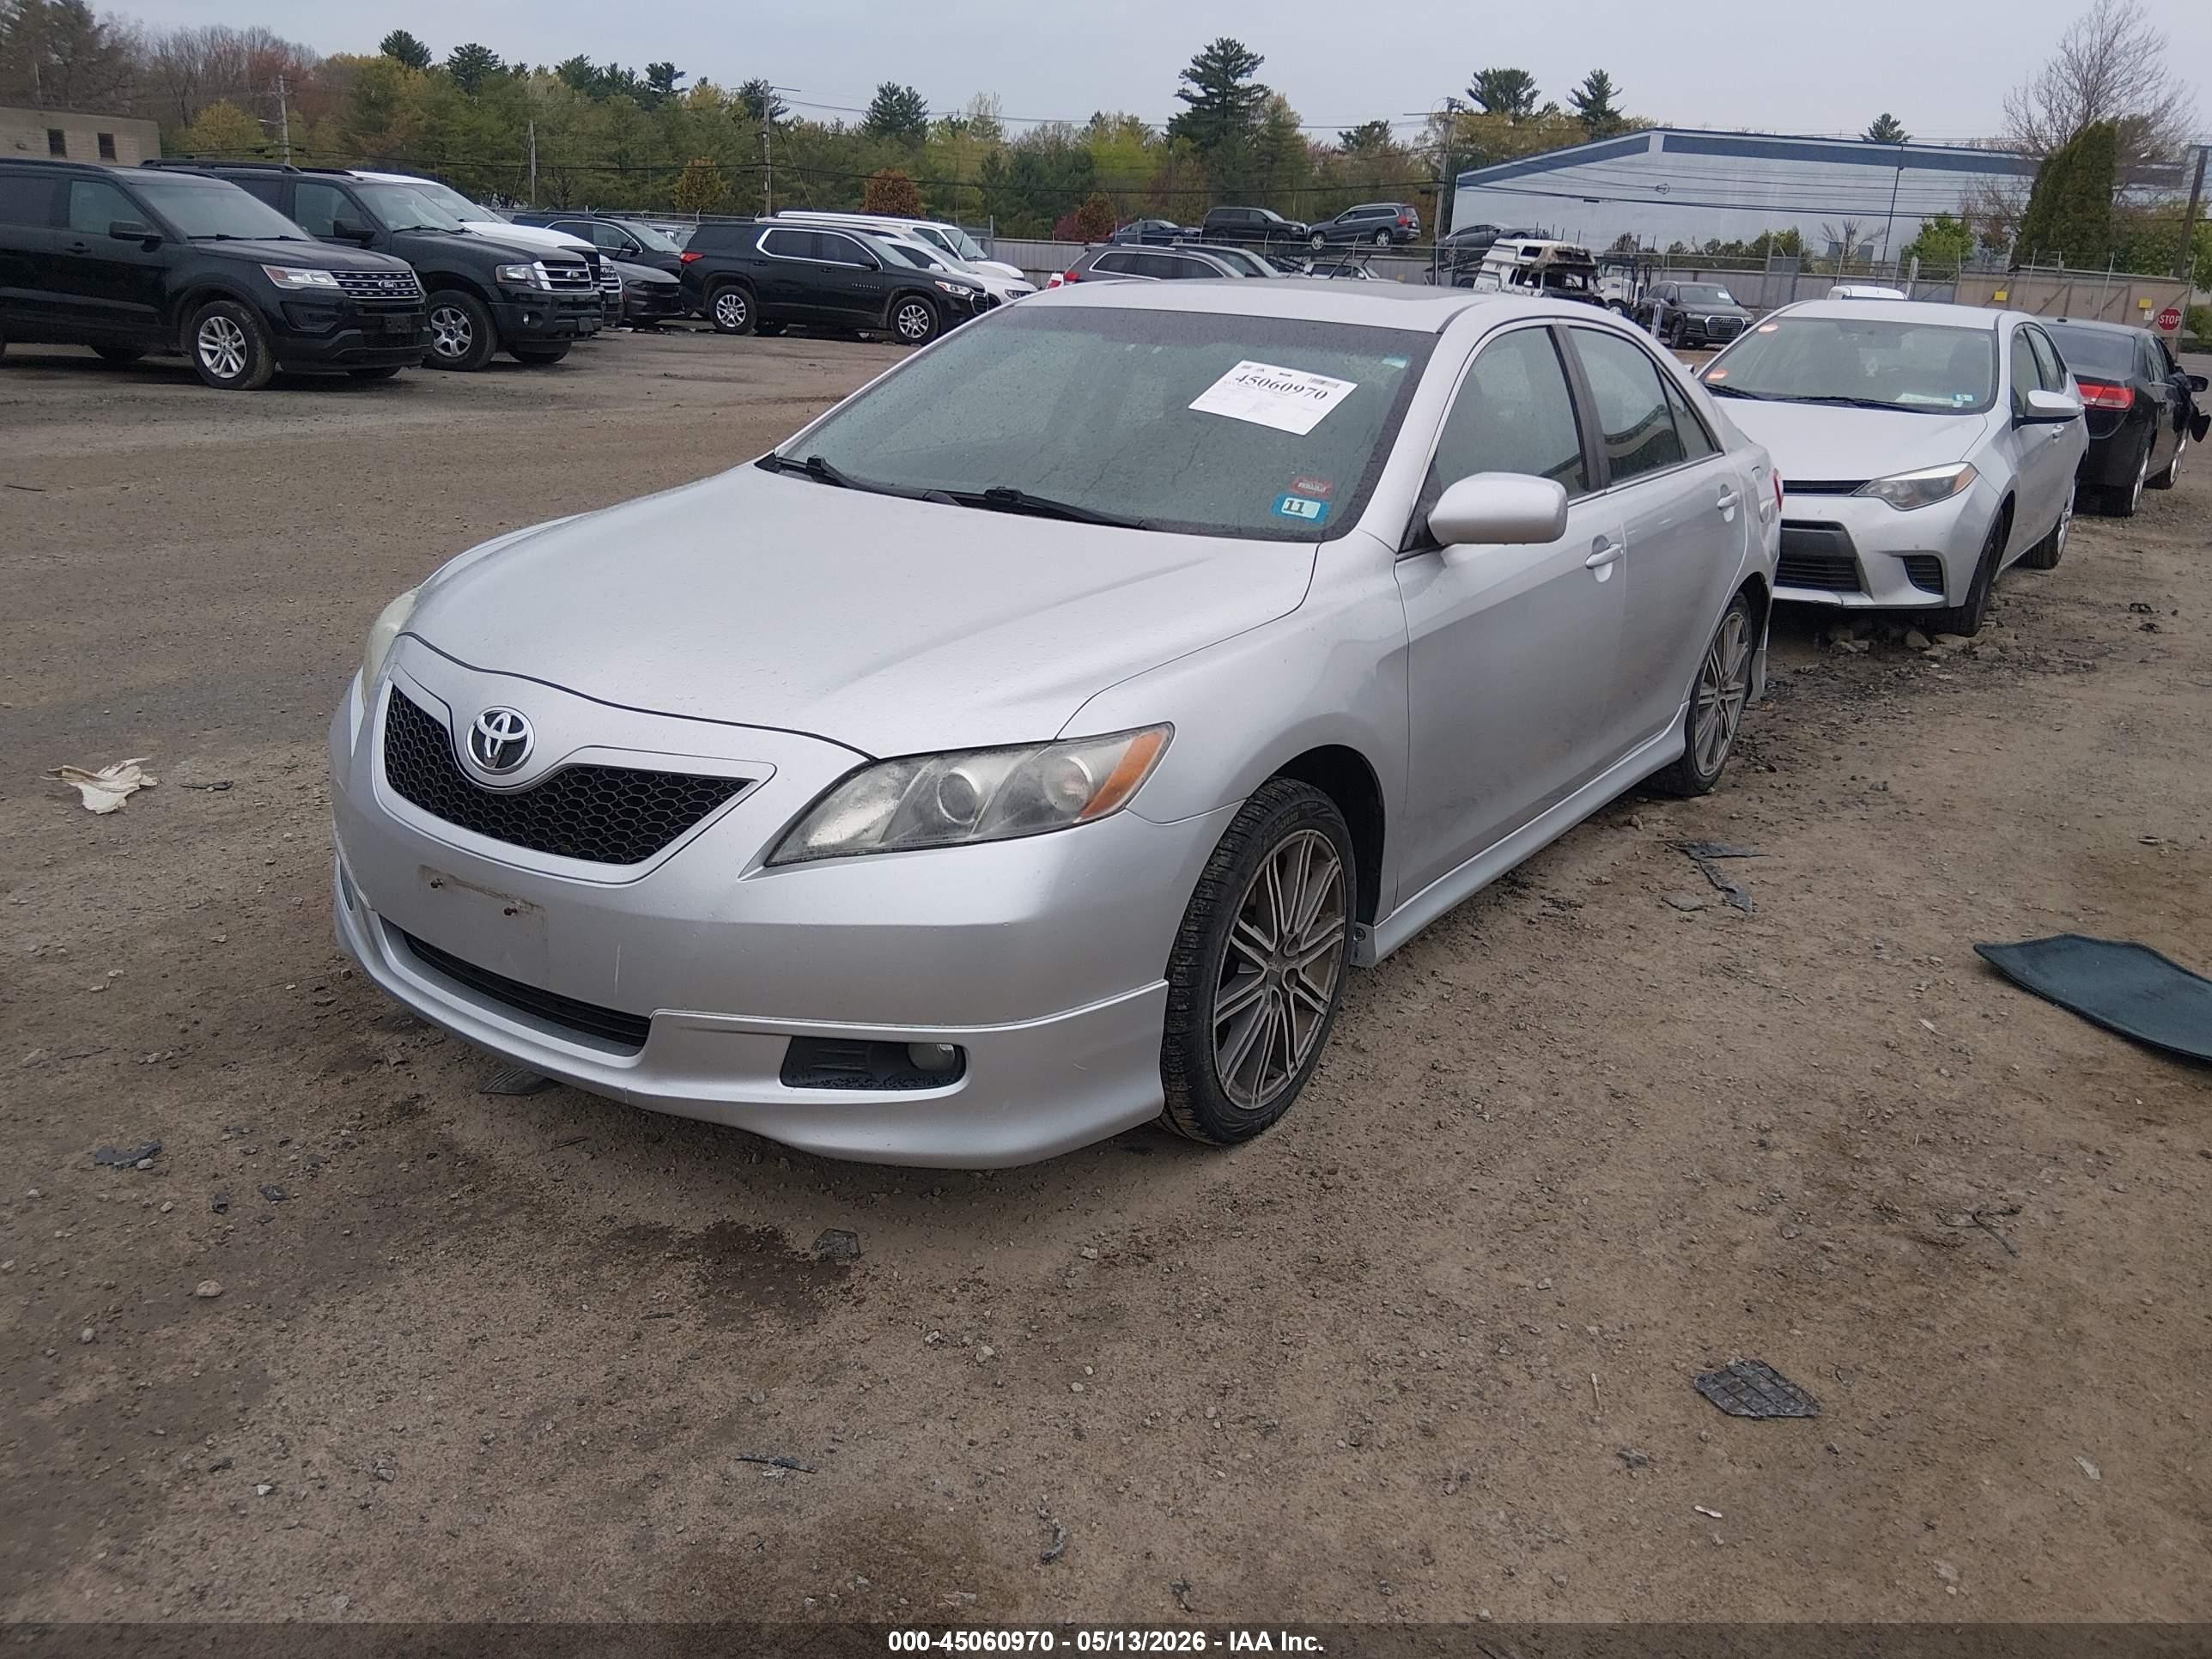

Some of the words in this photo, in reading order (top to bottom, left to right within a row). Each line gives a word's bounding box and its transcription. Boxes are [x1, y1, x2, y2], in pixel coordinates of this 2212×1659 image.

[2160, 315, 2181, 325] STOP
[1235, 374, 1328, 400] 45060970
[1283, 500, 1305, 514] 11
